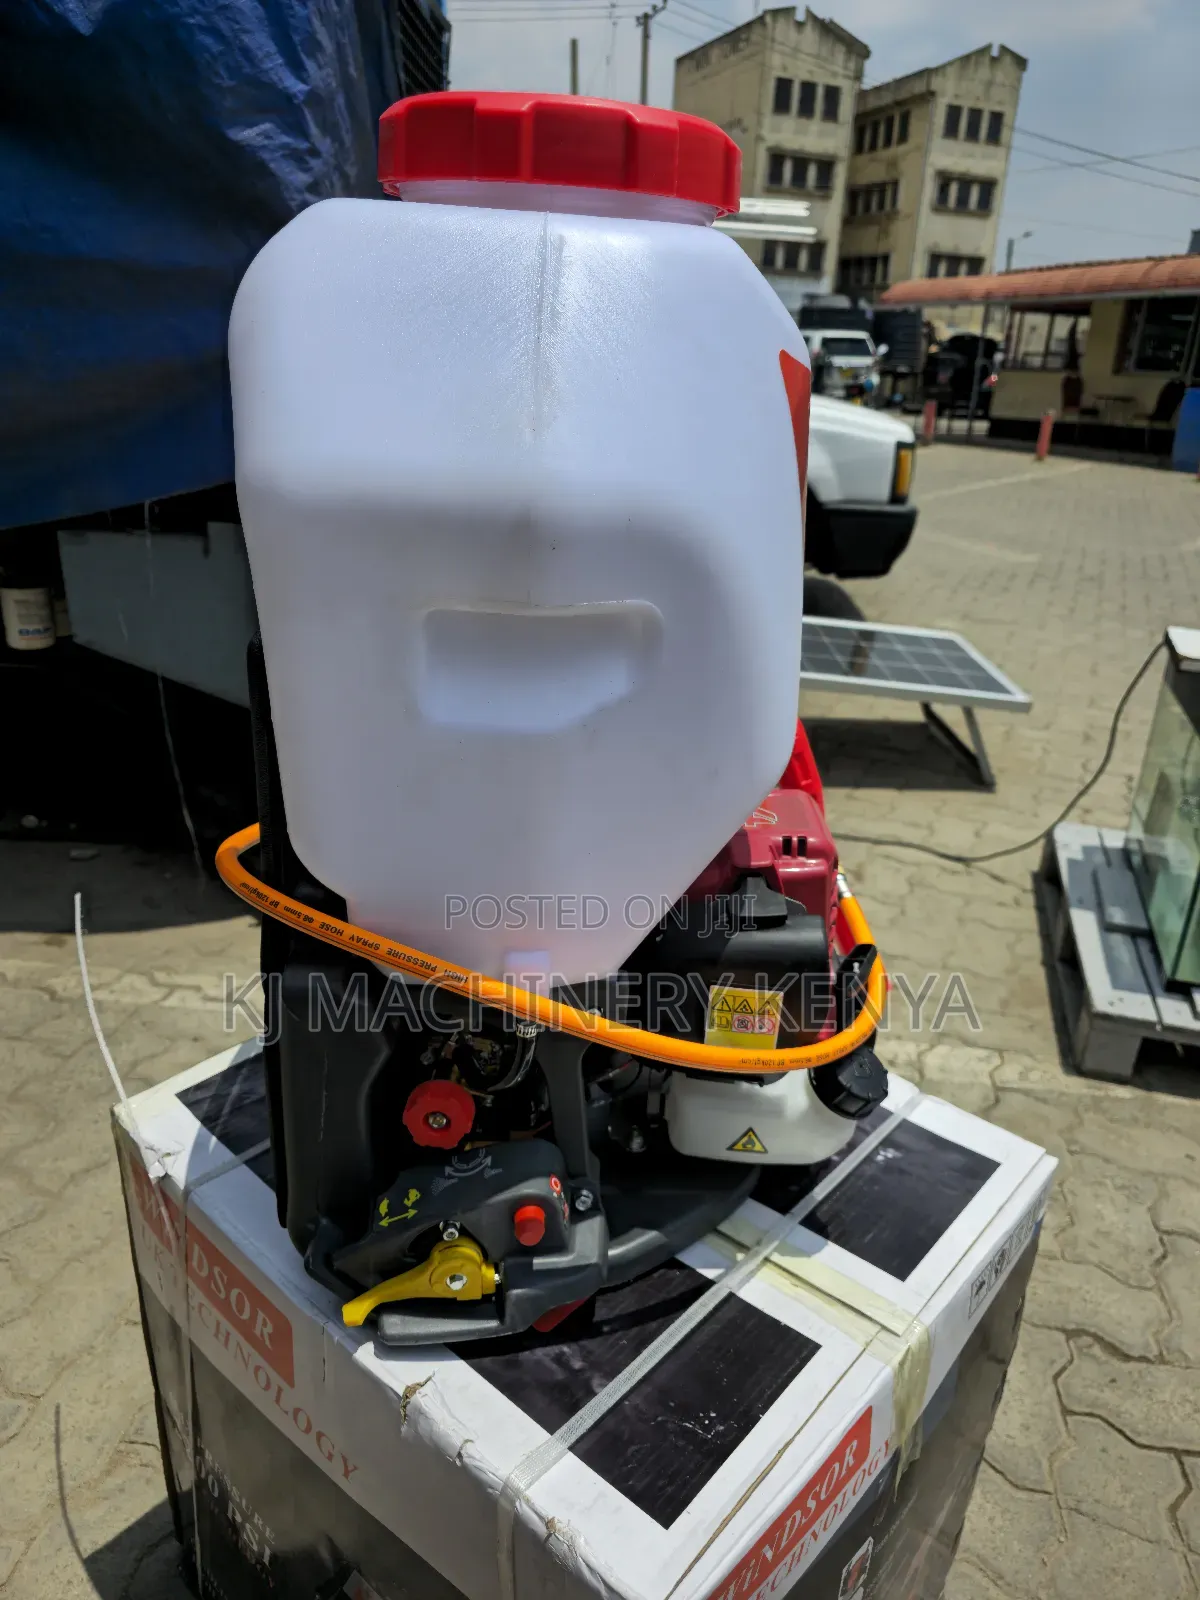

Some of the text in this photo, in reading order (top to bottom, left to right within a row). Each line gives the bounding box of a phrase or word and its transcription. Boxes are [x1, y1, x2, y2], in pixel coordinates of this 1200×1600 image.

[318, 921, 345, 937] HOSE
[348, 933, 381, 951] SPRAY
[386, 947, 438, 973] PRESSURE
